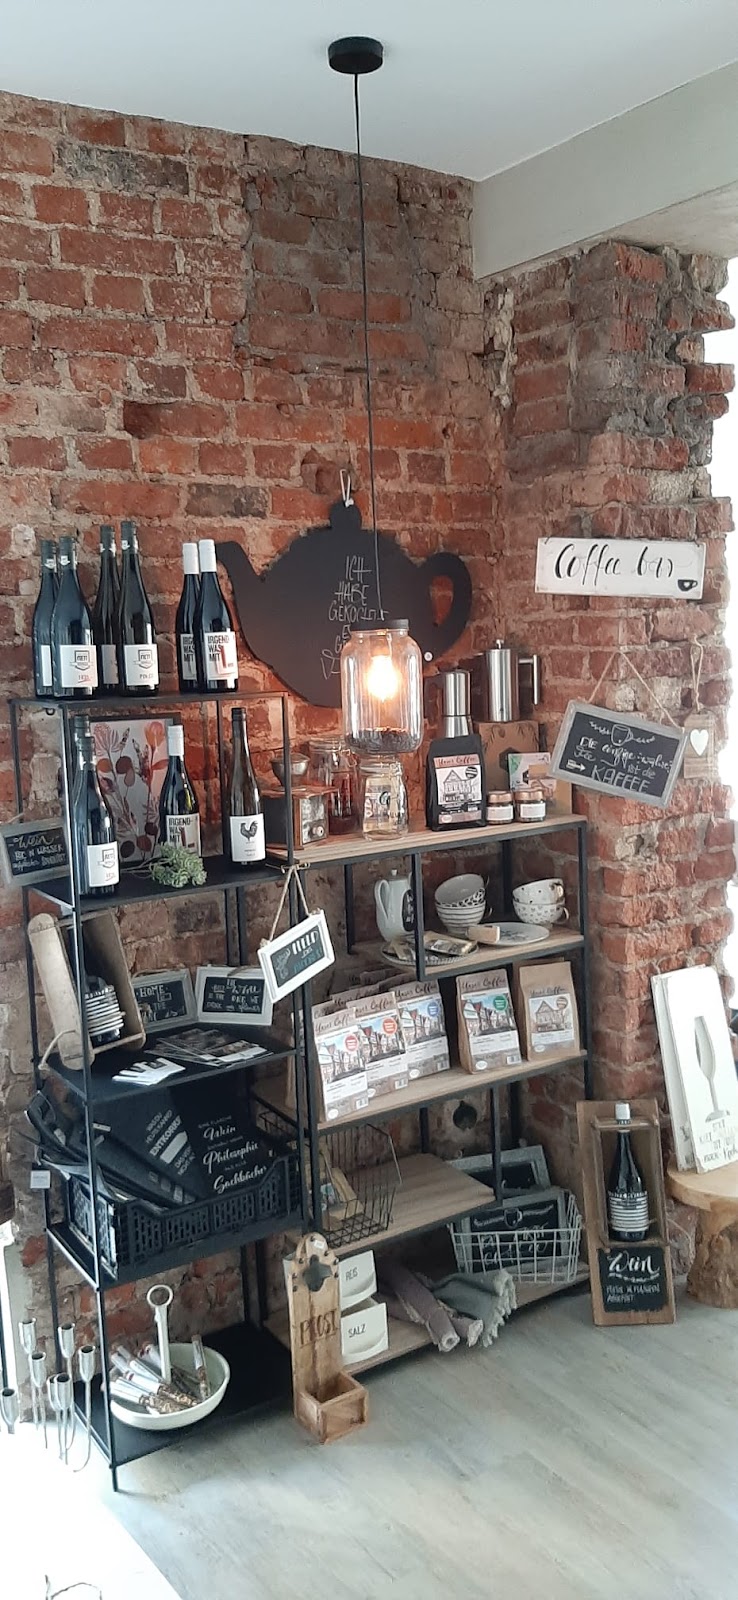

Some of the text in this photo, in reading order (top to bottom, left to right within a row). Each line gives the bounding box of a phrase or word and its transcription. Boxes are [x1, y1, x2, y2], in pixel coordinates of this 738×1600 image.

[345, 555, 372, 583] ICH
[554, 543, 674, 586] Coffee bar
[334, 580, 370, 606] HABE
[209, 653, 220, 661] MIT
[580, 737, 598, 749] DIE
[591, 765, 650, 793] KAFFEE
[415, 984, 437, 994] Coffee
[483, 977, 506, 987] Coffee
[140, 985, 165, 998] HOME
[371, 999, 393, 1010] Coffee
[203, 1141, 259, 1174] Philosophie
[607, 1250, 660, 1274] Wein
[346, 1267, 358, 1281] REIS
[348, 1323, 366, 1338] SALZ
